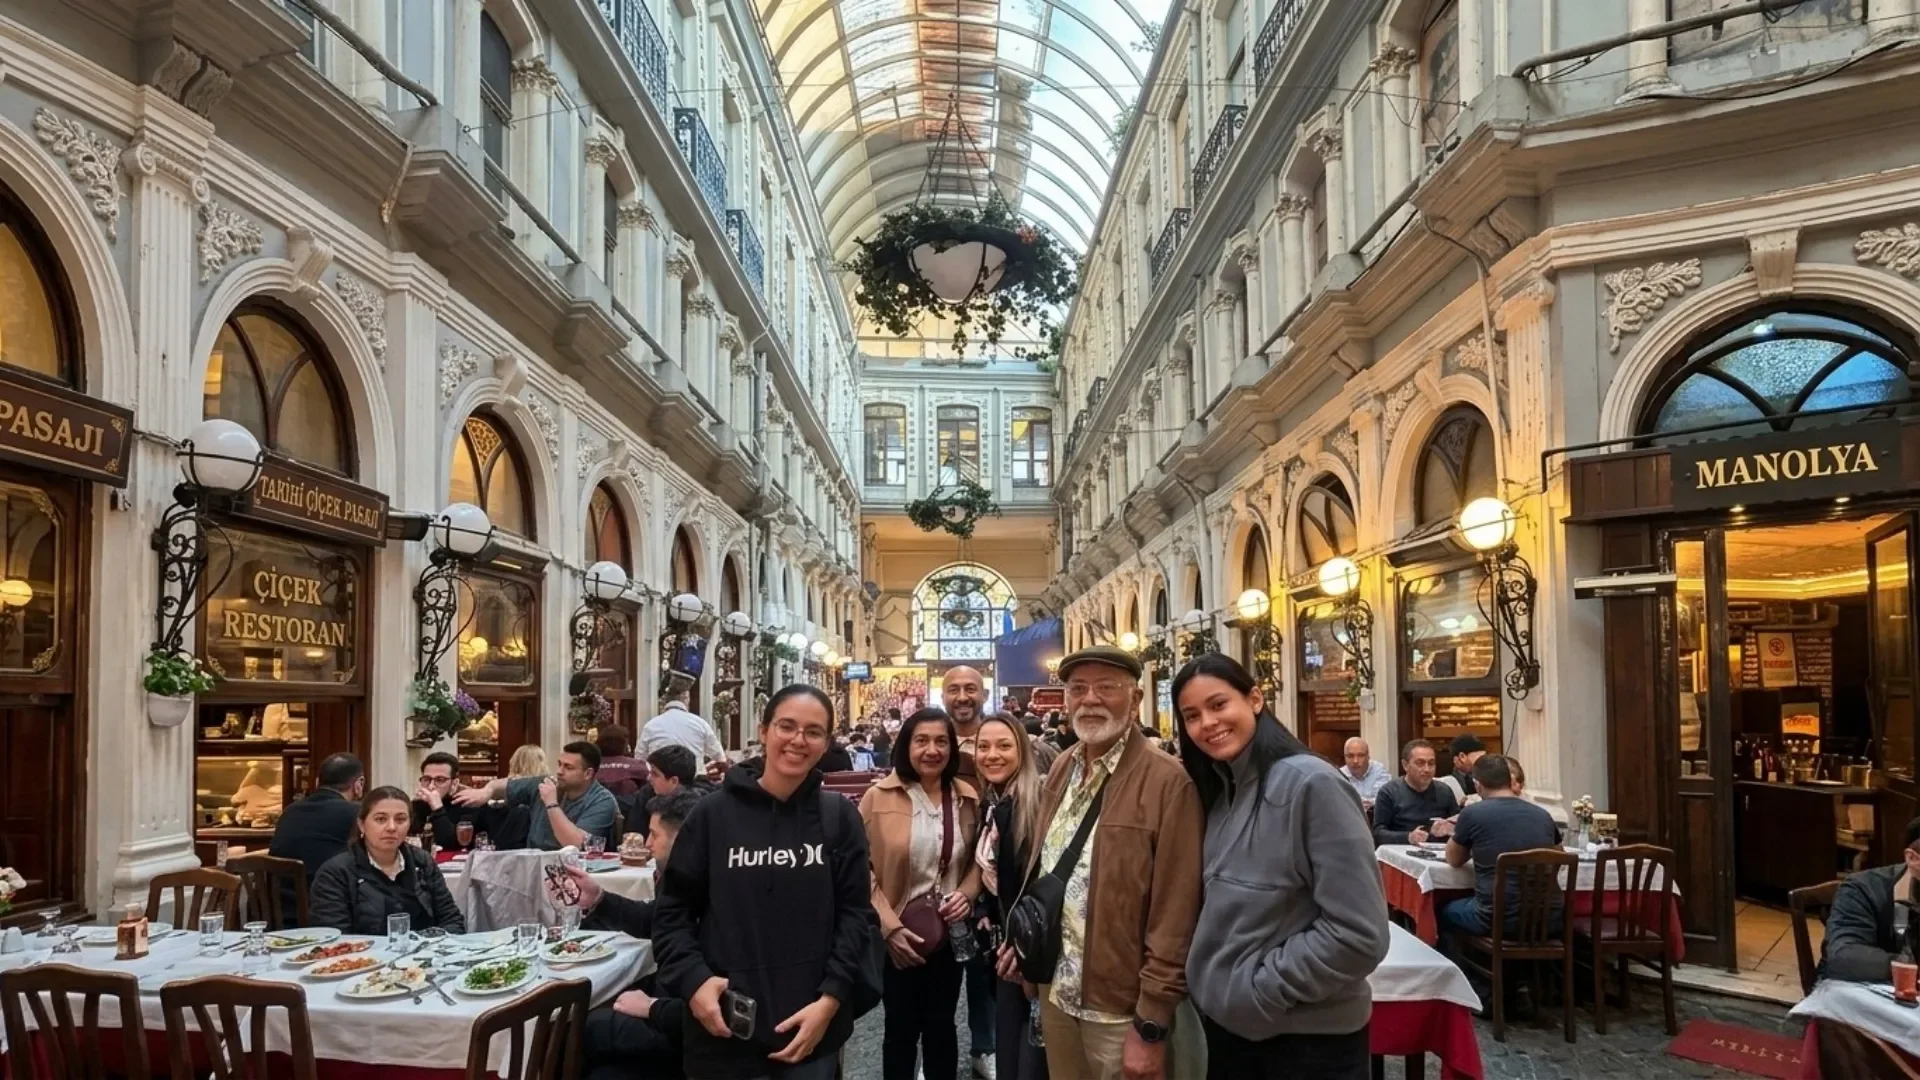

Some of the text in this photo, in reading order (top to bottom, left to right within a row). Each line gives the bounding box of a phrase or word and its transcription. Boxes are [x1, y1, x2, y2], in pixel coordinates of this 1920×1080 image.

[0, 400, 104, 456] PASAJI
[1695, 442, 1879, 489] MANOLYA
[306, 486, 342, 520] ÇİÇEK
[254, 565, 322, 607] ÇİÇEK
[223, 610, 346, 647] RESTORAN
[728, 846, 797, 868] Hurley
